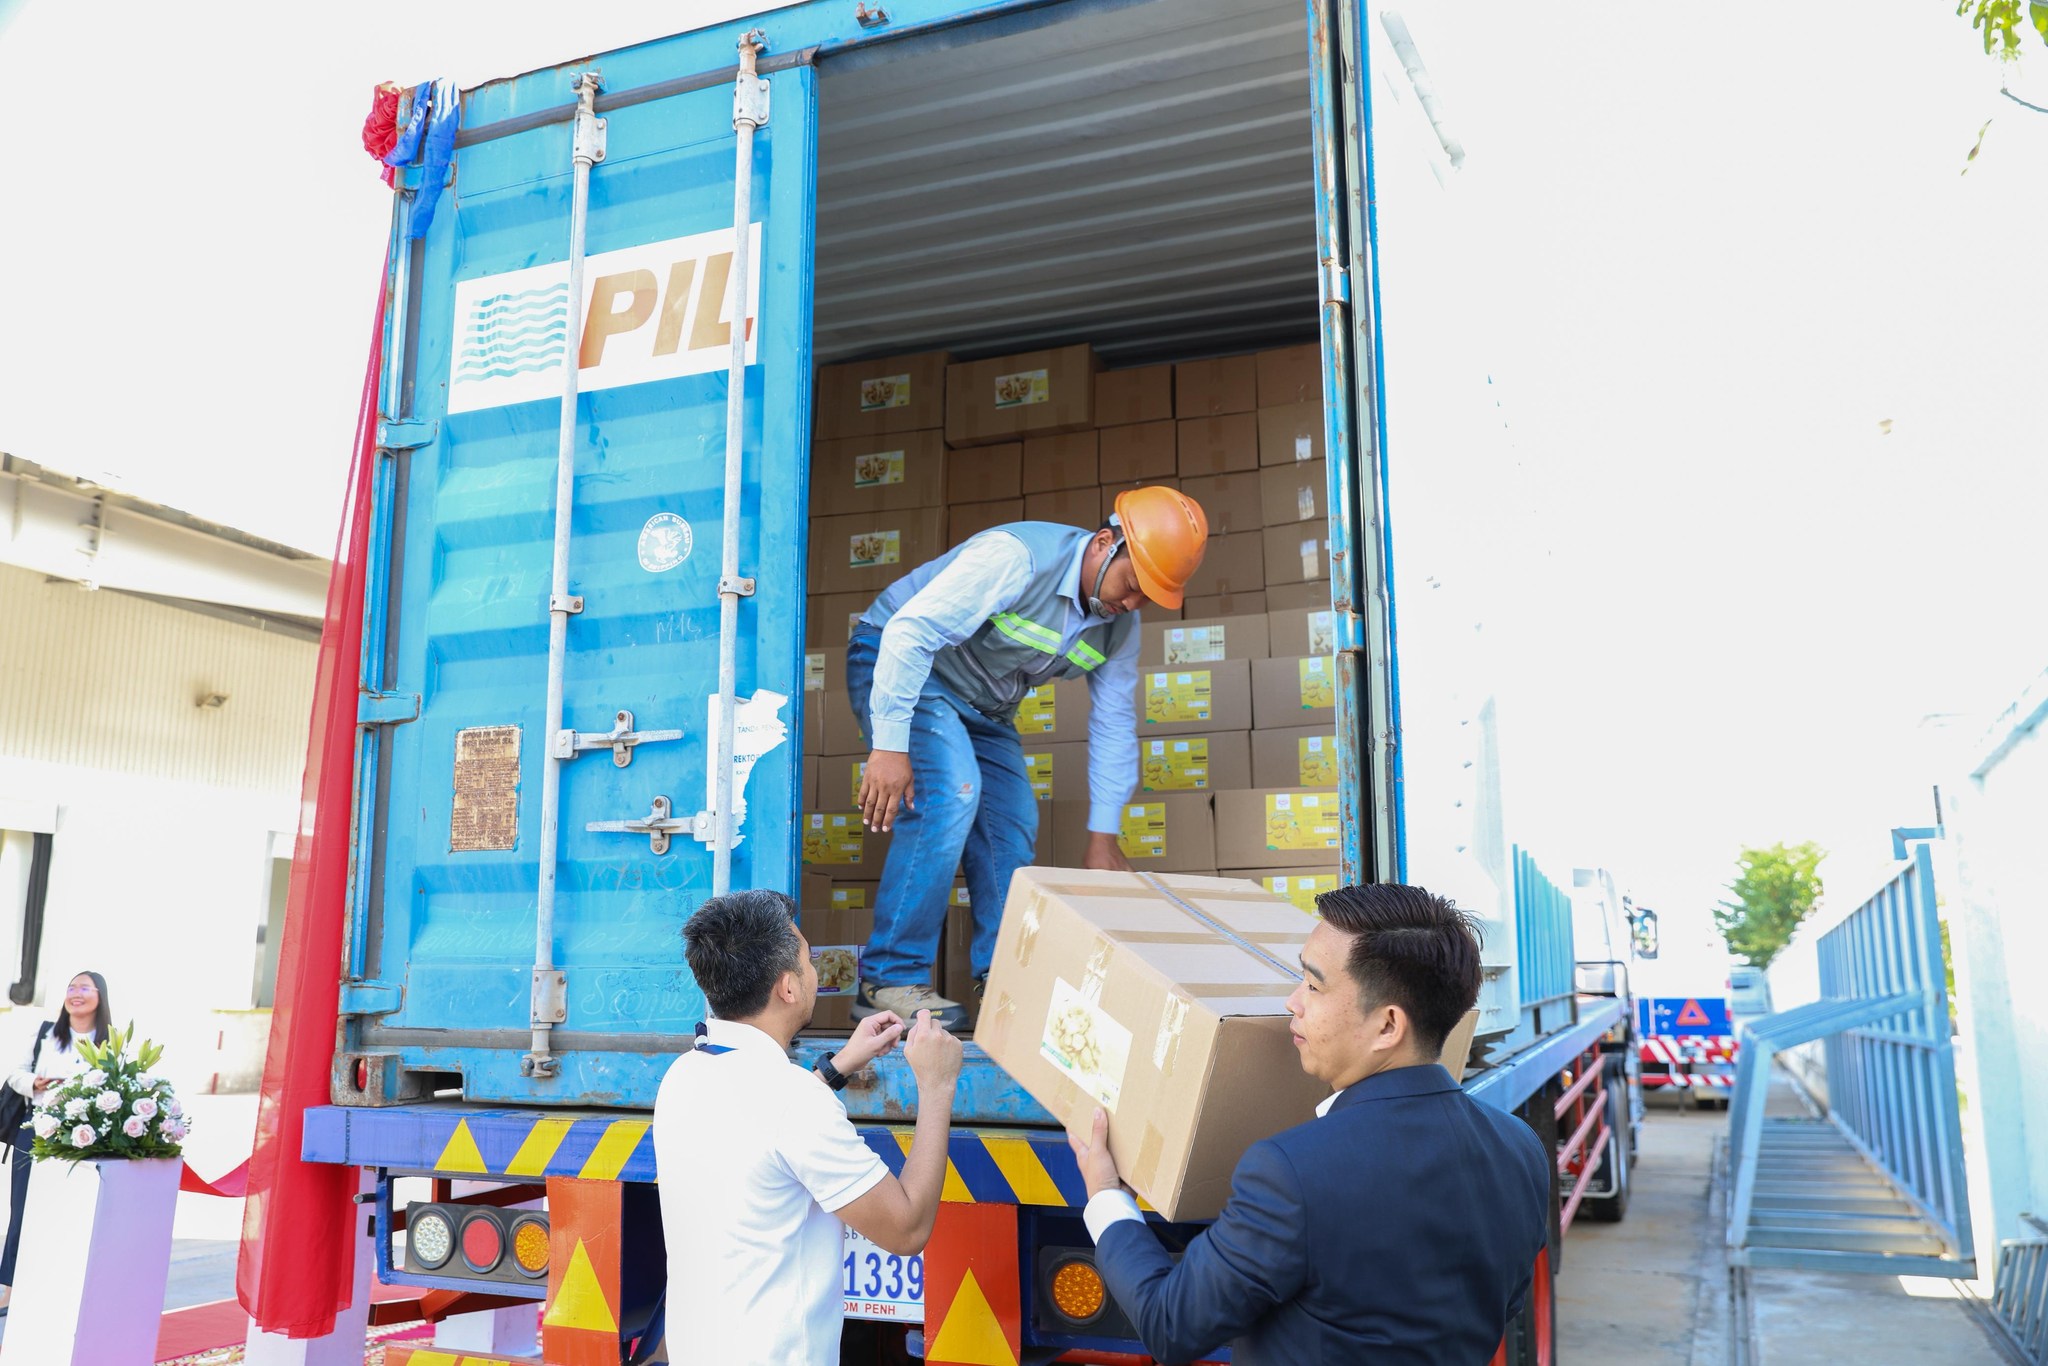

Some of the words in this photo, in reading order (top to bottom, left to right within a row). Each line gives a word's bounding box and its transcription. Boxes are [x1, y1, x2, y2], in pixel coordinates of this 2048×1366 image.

[579, 251, 754, 370] PIL
[640, 515, 669, 547] AMERICAN
[671, 516, 691, 544] BUREAU
[844, 1251, 924, 1300] 1339
[844, 1301, 858, 1312] OM
[865, 1303, 895, 1315] PENH
